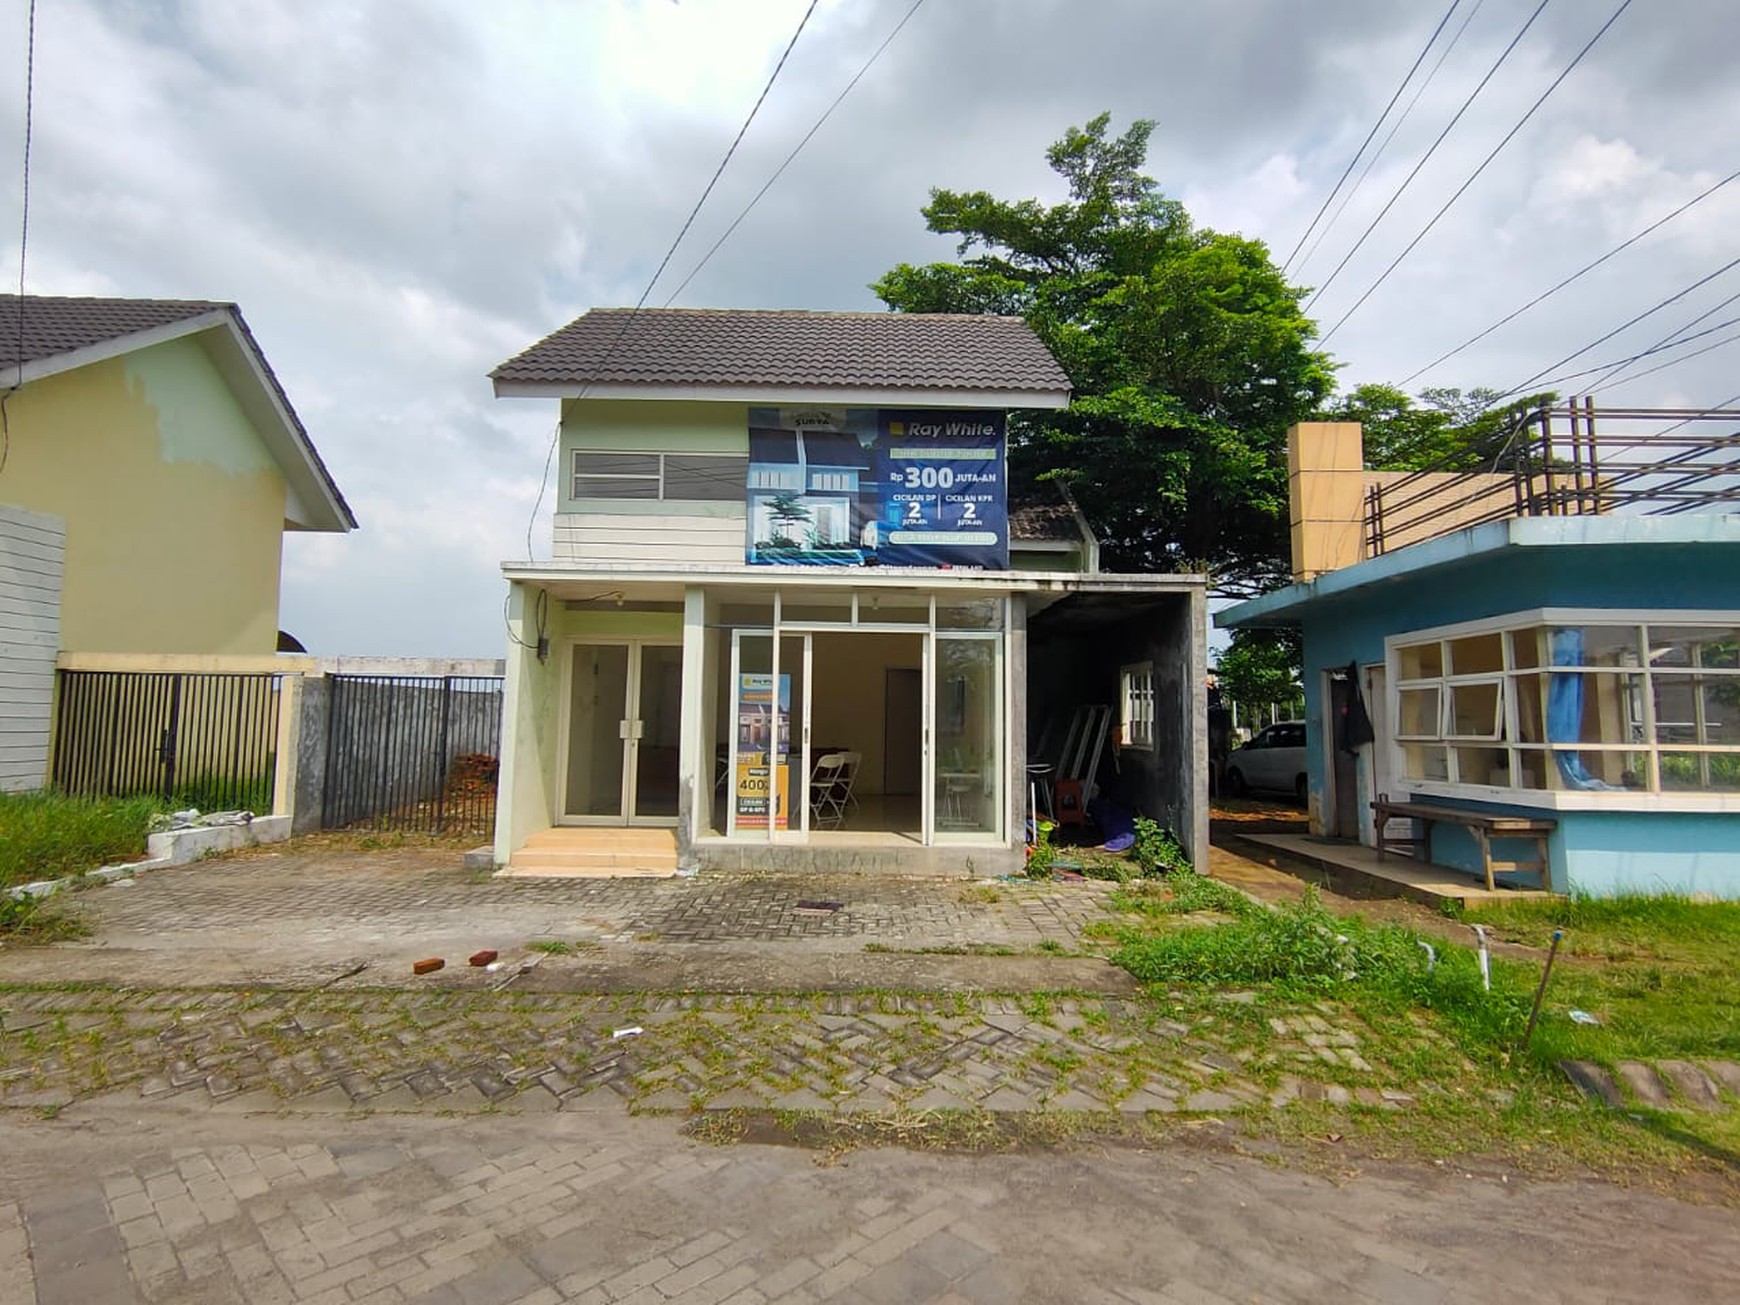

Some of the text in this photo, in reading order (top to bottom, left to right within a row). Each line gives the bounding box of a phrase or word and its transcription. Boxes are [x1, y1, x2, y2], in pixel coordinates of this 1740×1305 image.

[909, 423, 942, 437] Ray
[890, 467, 997, 489] Rp 300 JUTA-AN
[893, 494, 937, 502] CICILAN DP
[908, 502, 921, 518] 2
[963, 503, 976, 519] 2
[739, 780, 764, 790] 400
